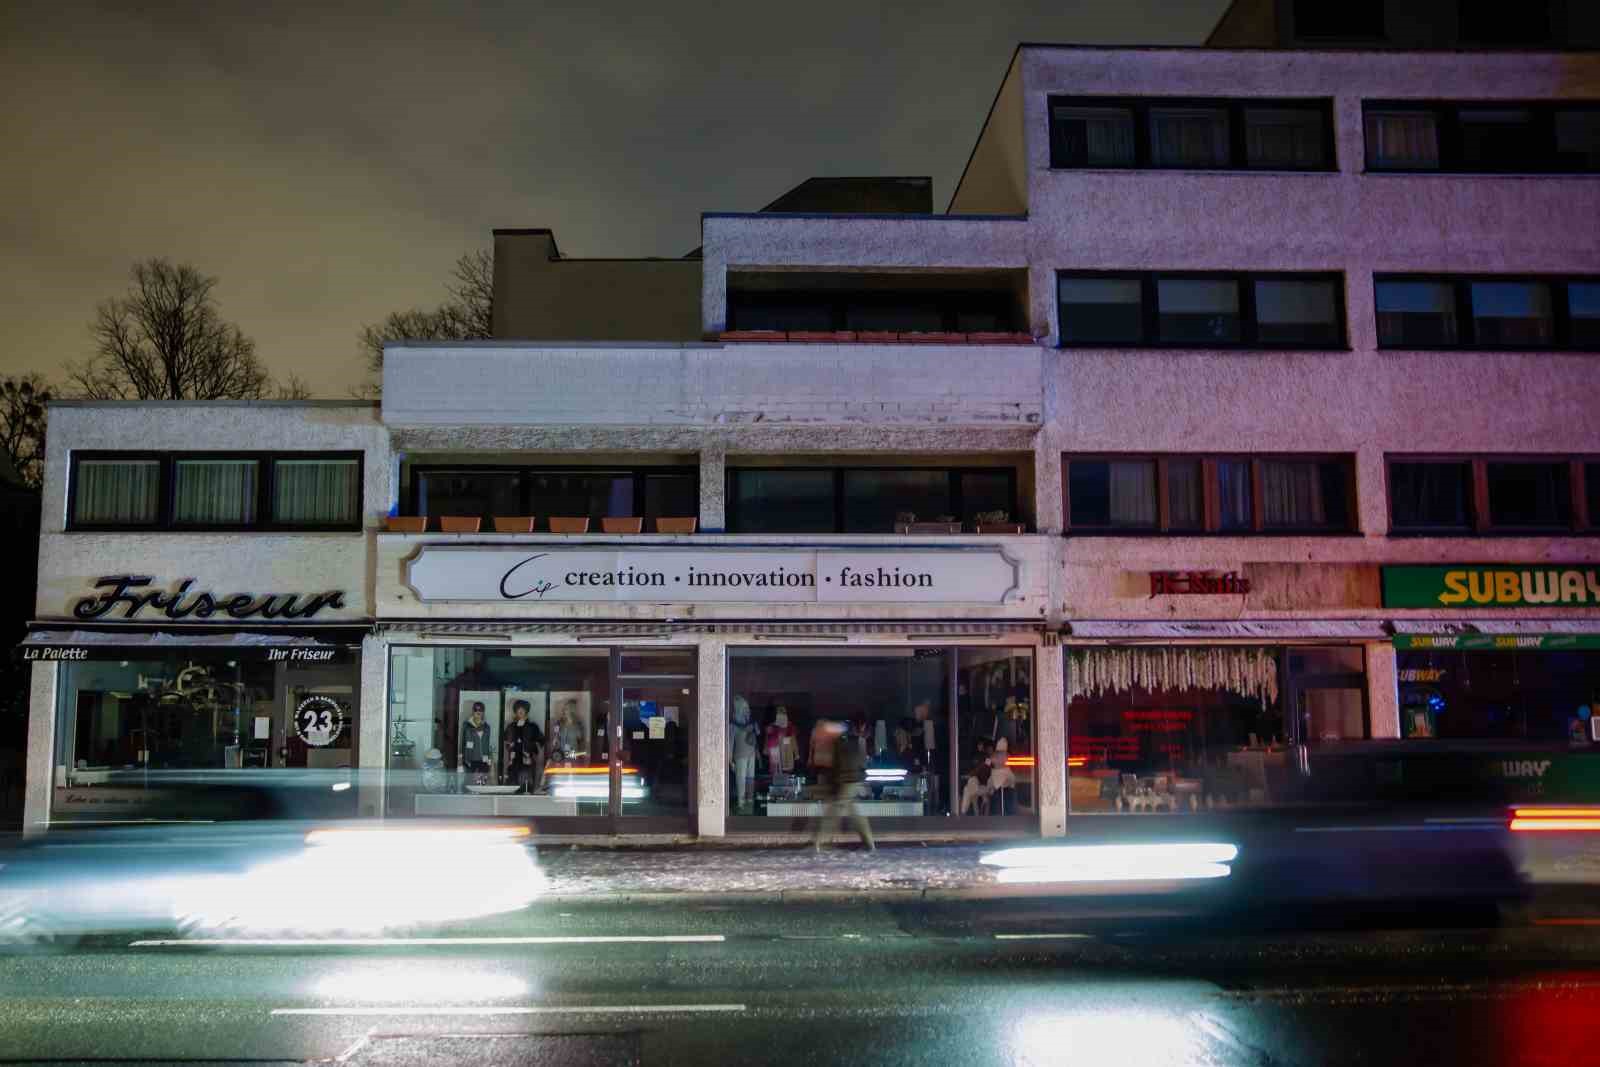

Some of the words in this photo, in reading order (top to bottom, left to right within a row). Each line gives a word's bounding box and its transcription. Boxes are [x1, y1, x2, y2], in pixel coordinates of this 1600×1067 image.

[564, 566, 666, 587] creation
[687, 566, 816, 587] innovation
[839, 566, 934, 587] fashion
[74, 574, 346, 620] Friseur
[1409, 635, 1459, 649] SUBWAY
[1495, 635, 1544, 649] SUBWAY
[23, 647, 41, 660] La
[42, 647, 90, 660] Palette
[267, 647, 288, 660] Ihr
[290, 647, 336, 660] Friseur
[1399, 667, 1447, 683] UBWAY
[303, 710, 333, 733] 23
